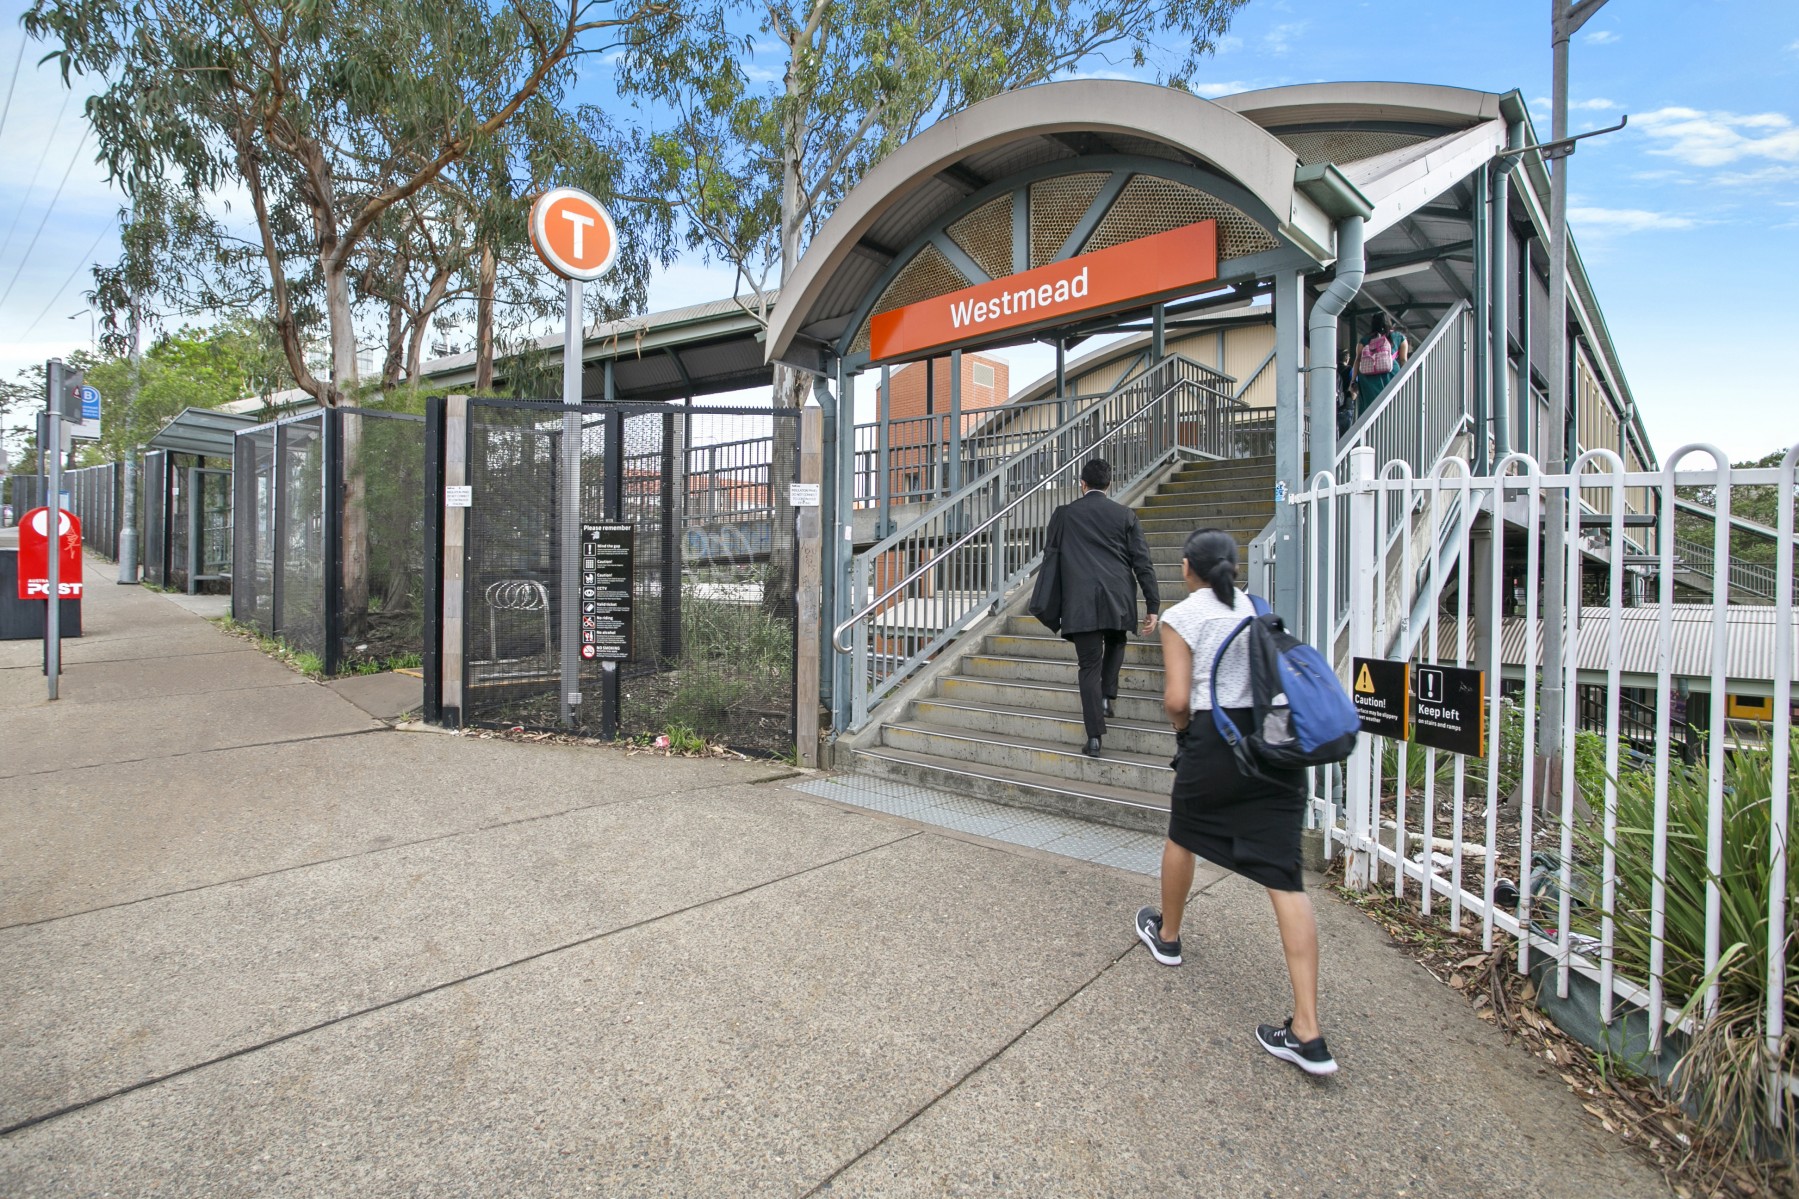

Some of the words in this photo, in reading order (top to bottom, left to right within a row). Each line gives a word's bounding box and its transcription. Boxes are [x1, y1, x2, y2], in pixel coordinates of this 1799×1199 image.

[561, 209, 594, 260] T
[950, 266, 1088, 328] Westmead
[84, 390, 92, 399] B
[1355, 694, 1386, 709] Caution!
[1382, 712, 1398, 721] slippery
[1418, 703, 1441, 720] Keep
[1442, 707, 1460, 721] left
[1424, 719, 1437, 727] stairs
[1446, 723, 1462, 732] ramps
